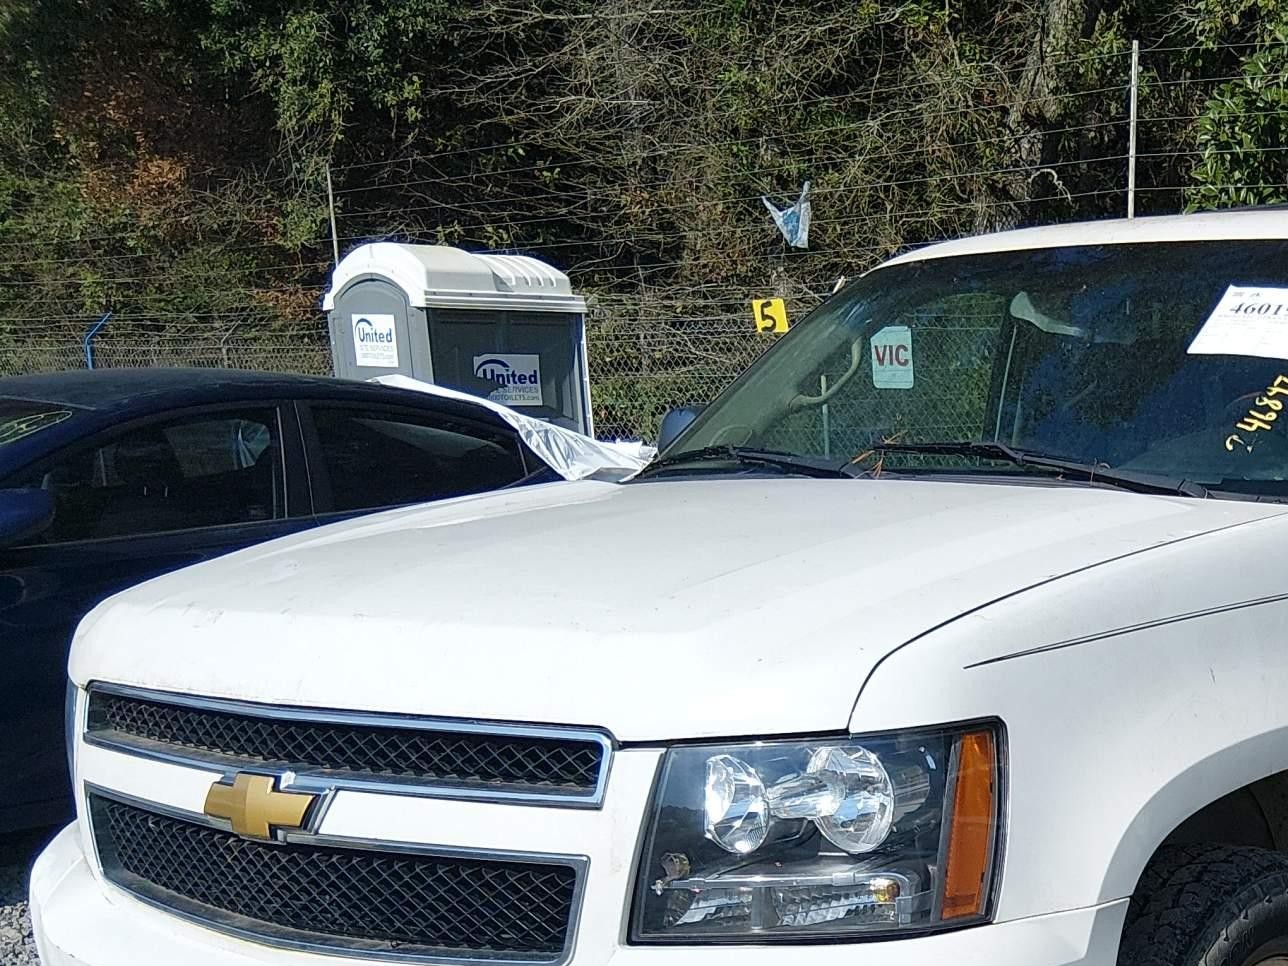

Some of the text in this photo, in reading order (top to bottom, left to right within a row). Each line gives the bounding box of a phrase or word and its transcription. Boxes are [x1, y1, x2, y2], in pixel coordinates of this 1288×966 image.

[760, 301, 777, 332] 5
[358, 327, 393, 343] United
[874, 344, 909, 367] VIC
[482, 368, 538, 385] United
